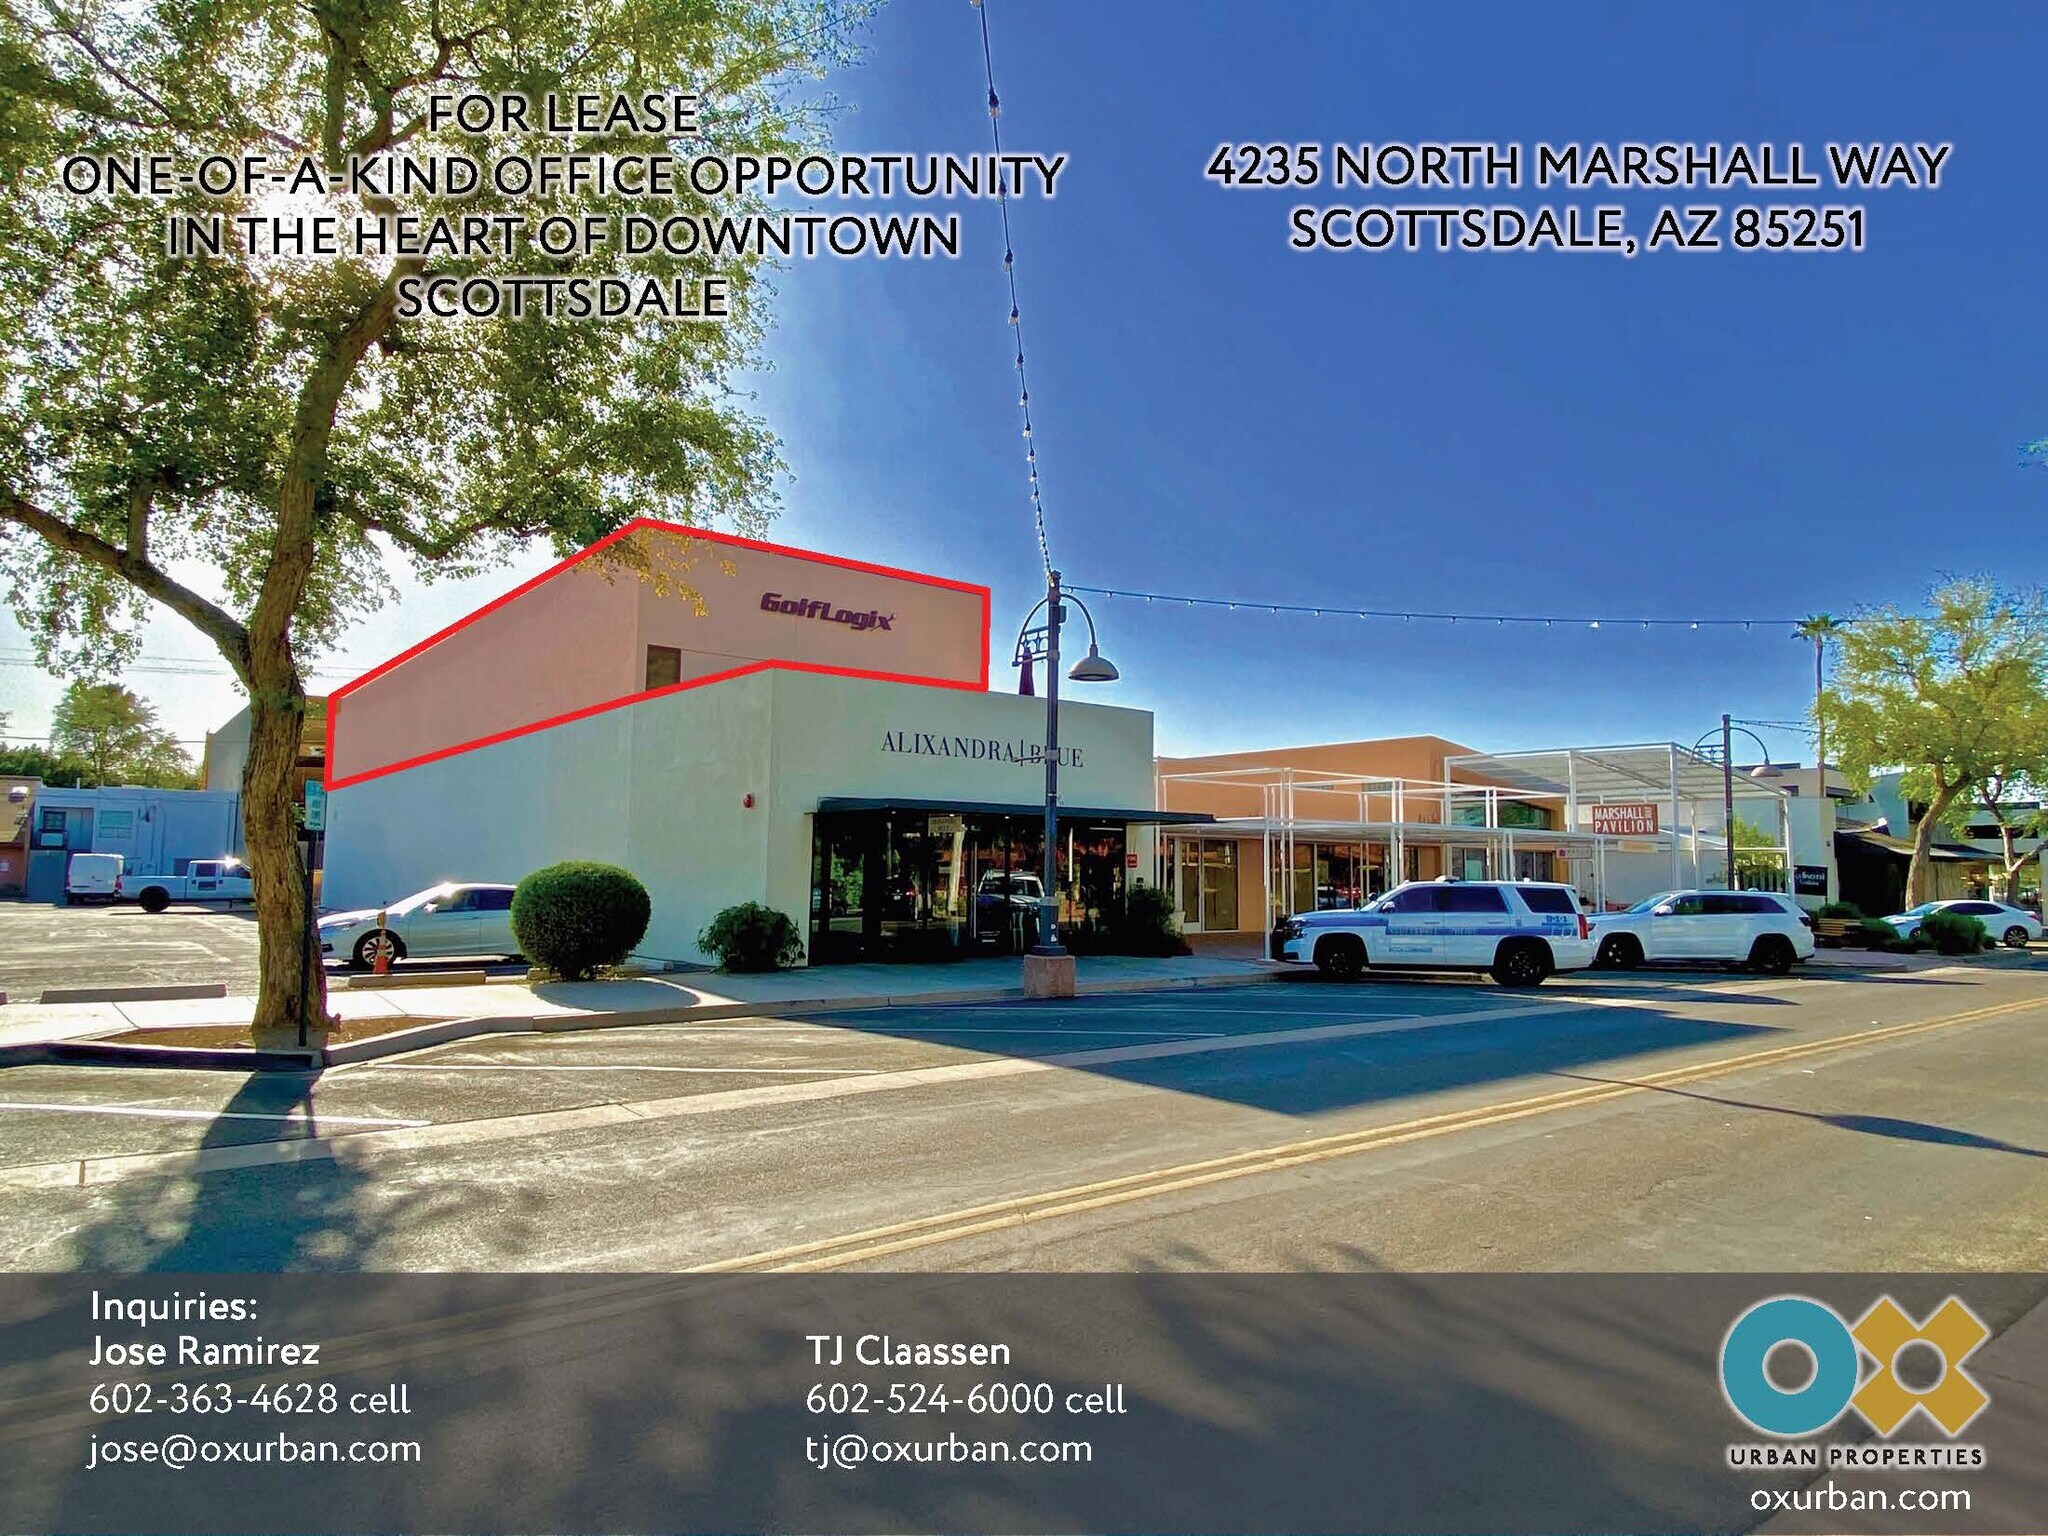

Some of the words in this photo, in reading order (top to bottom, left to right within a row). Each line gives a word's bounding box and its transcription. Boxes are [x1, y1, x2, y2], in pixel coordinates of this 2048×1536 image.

[760, 592, 896, 632] GolfLogix
[1030, 743, 1084, 768] BUE
[1594, 806, 1645, 820] MARSHALL
[1594, 819, 1654, 833] PAVILION
